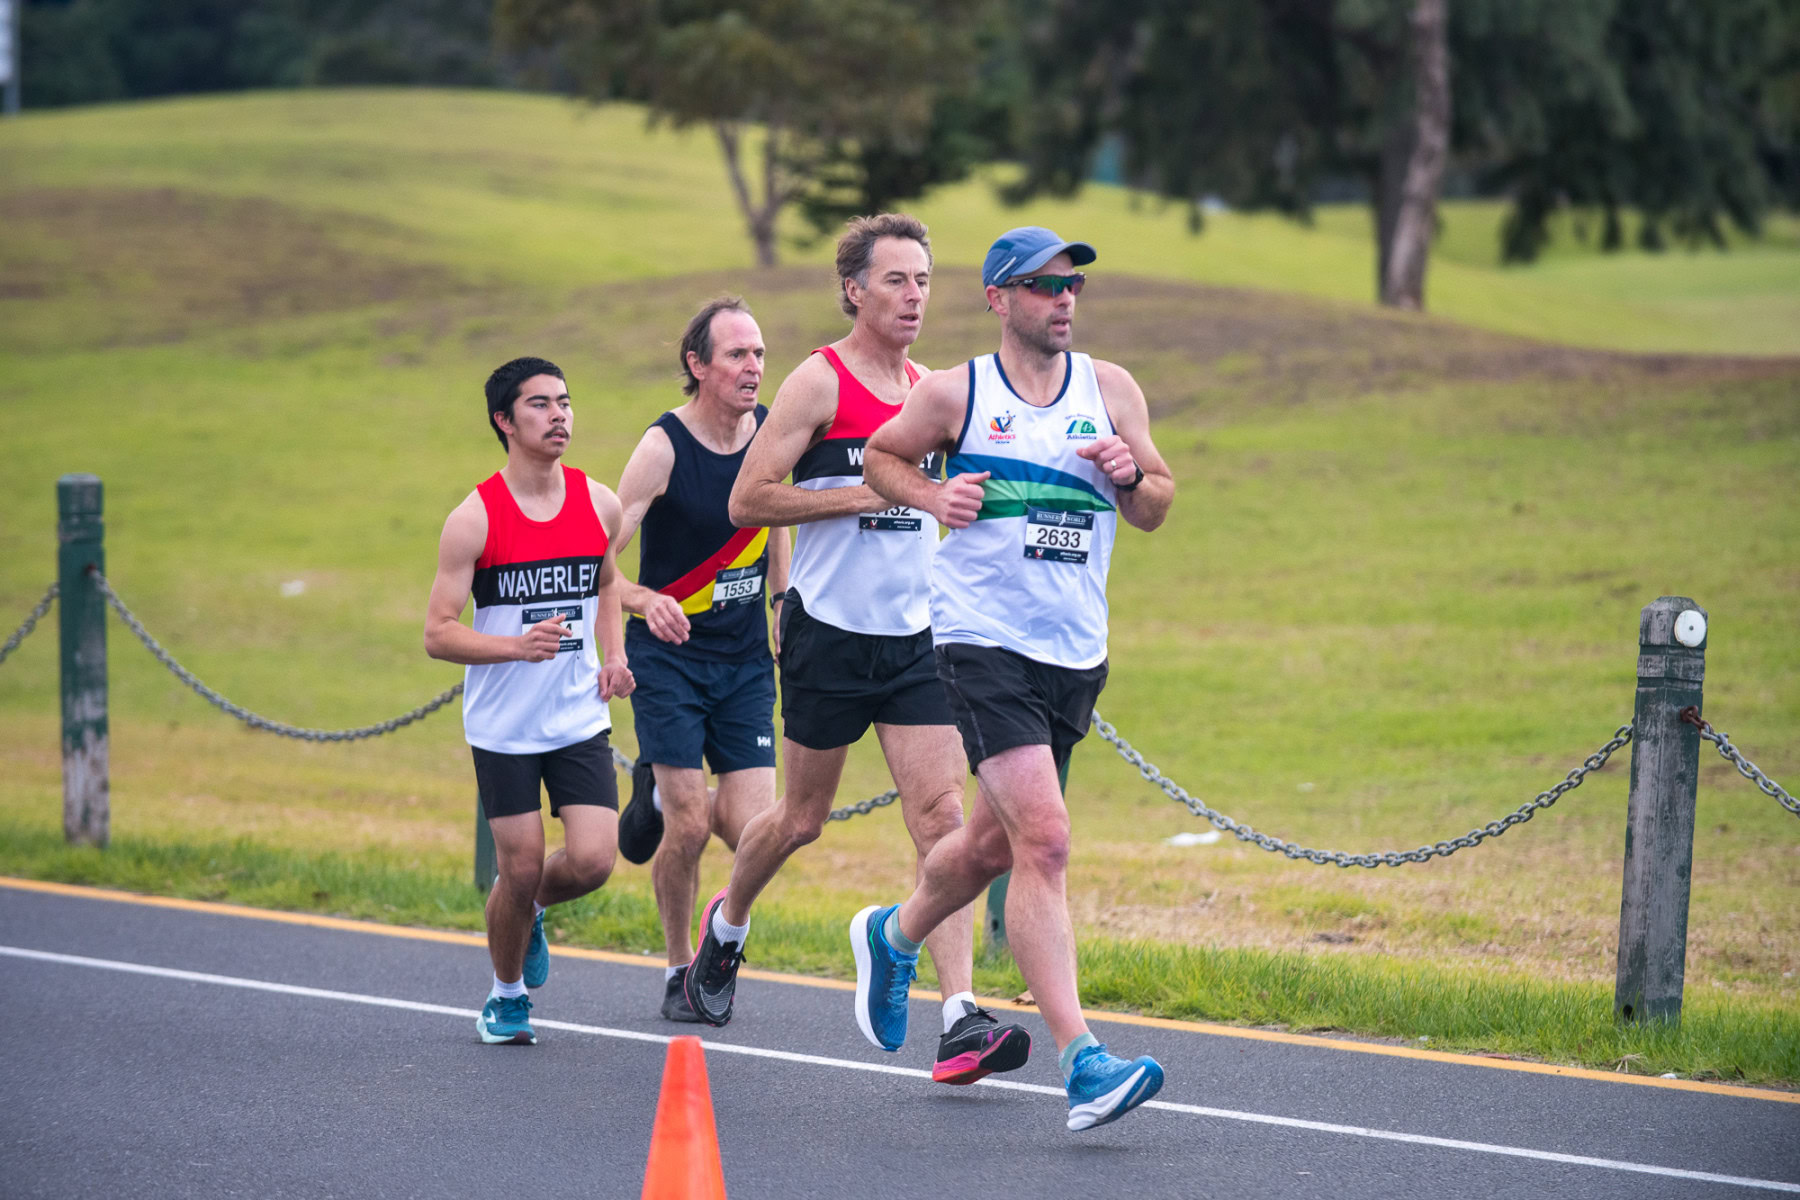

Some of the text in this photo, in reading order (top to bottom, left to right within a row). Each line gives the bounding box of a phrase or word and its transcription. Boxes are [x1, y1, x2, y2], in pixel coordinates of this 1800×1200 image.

[1036, 527, 1081, 548] 2633
[498, 563, 598, 598] WAVERLEY
[723, 580, 753, 598] 1553
